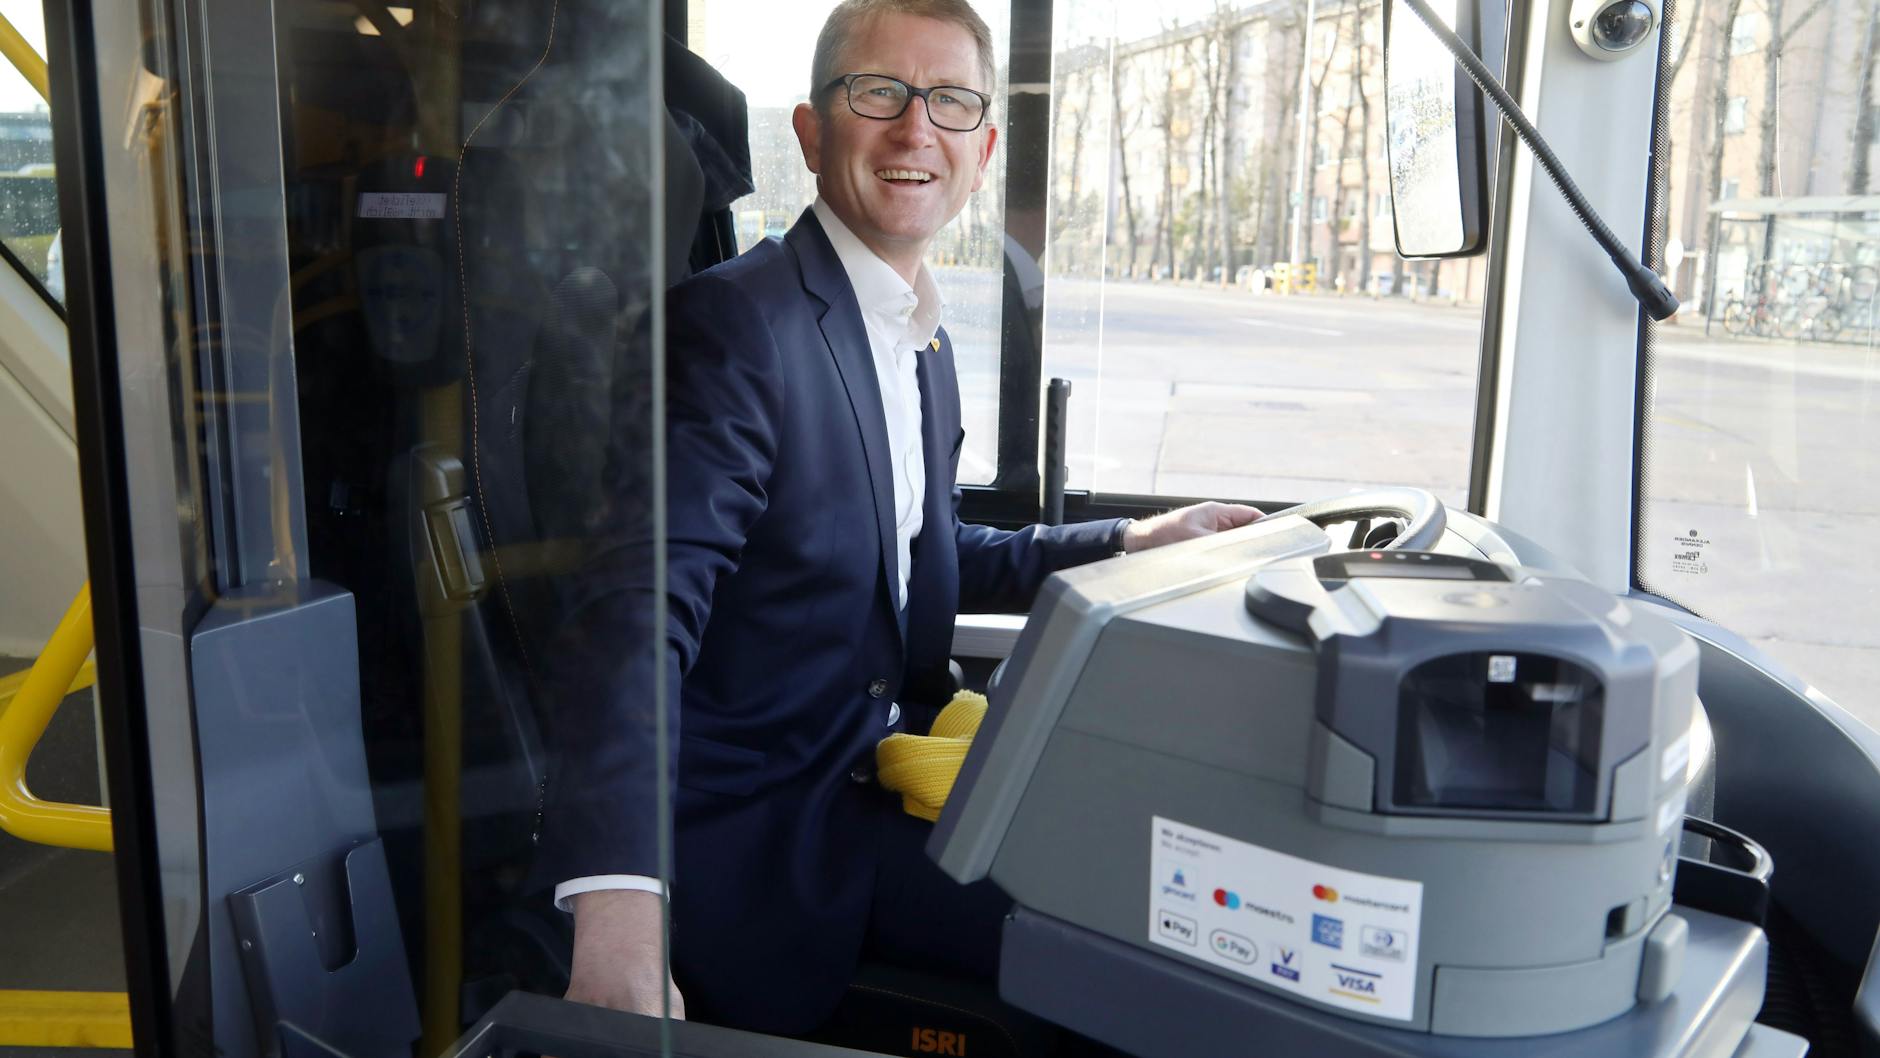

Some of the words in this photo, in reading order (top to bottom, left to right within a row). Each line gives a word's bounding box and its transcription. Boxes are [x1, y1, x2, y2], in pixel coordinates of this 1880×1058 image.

[1245, 902, 1295, 924] maestro
[1343, 895, 1409, 913] mastercard
[1172, 921, 1193, 939] Pay
[1229, 941, 1250, 958] Pay
[1337, 974, 1376, 994] VISA
[912, 1027, 966, 1056] ISRI
